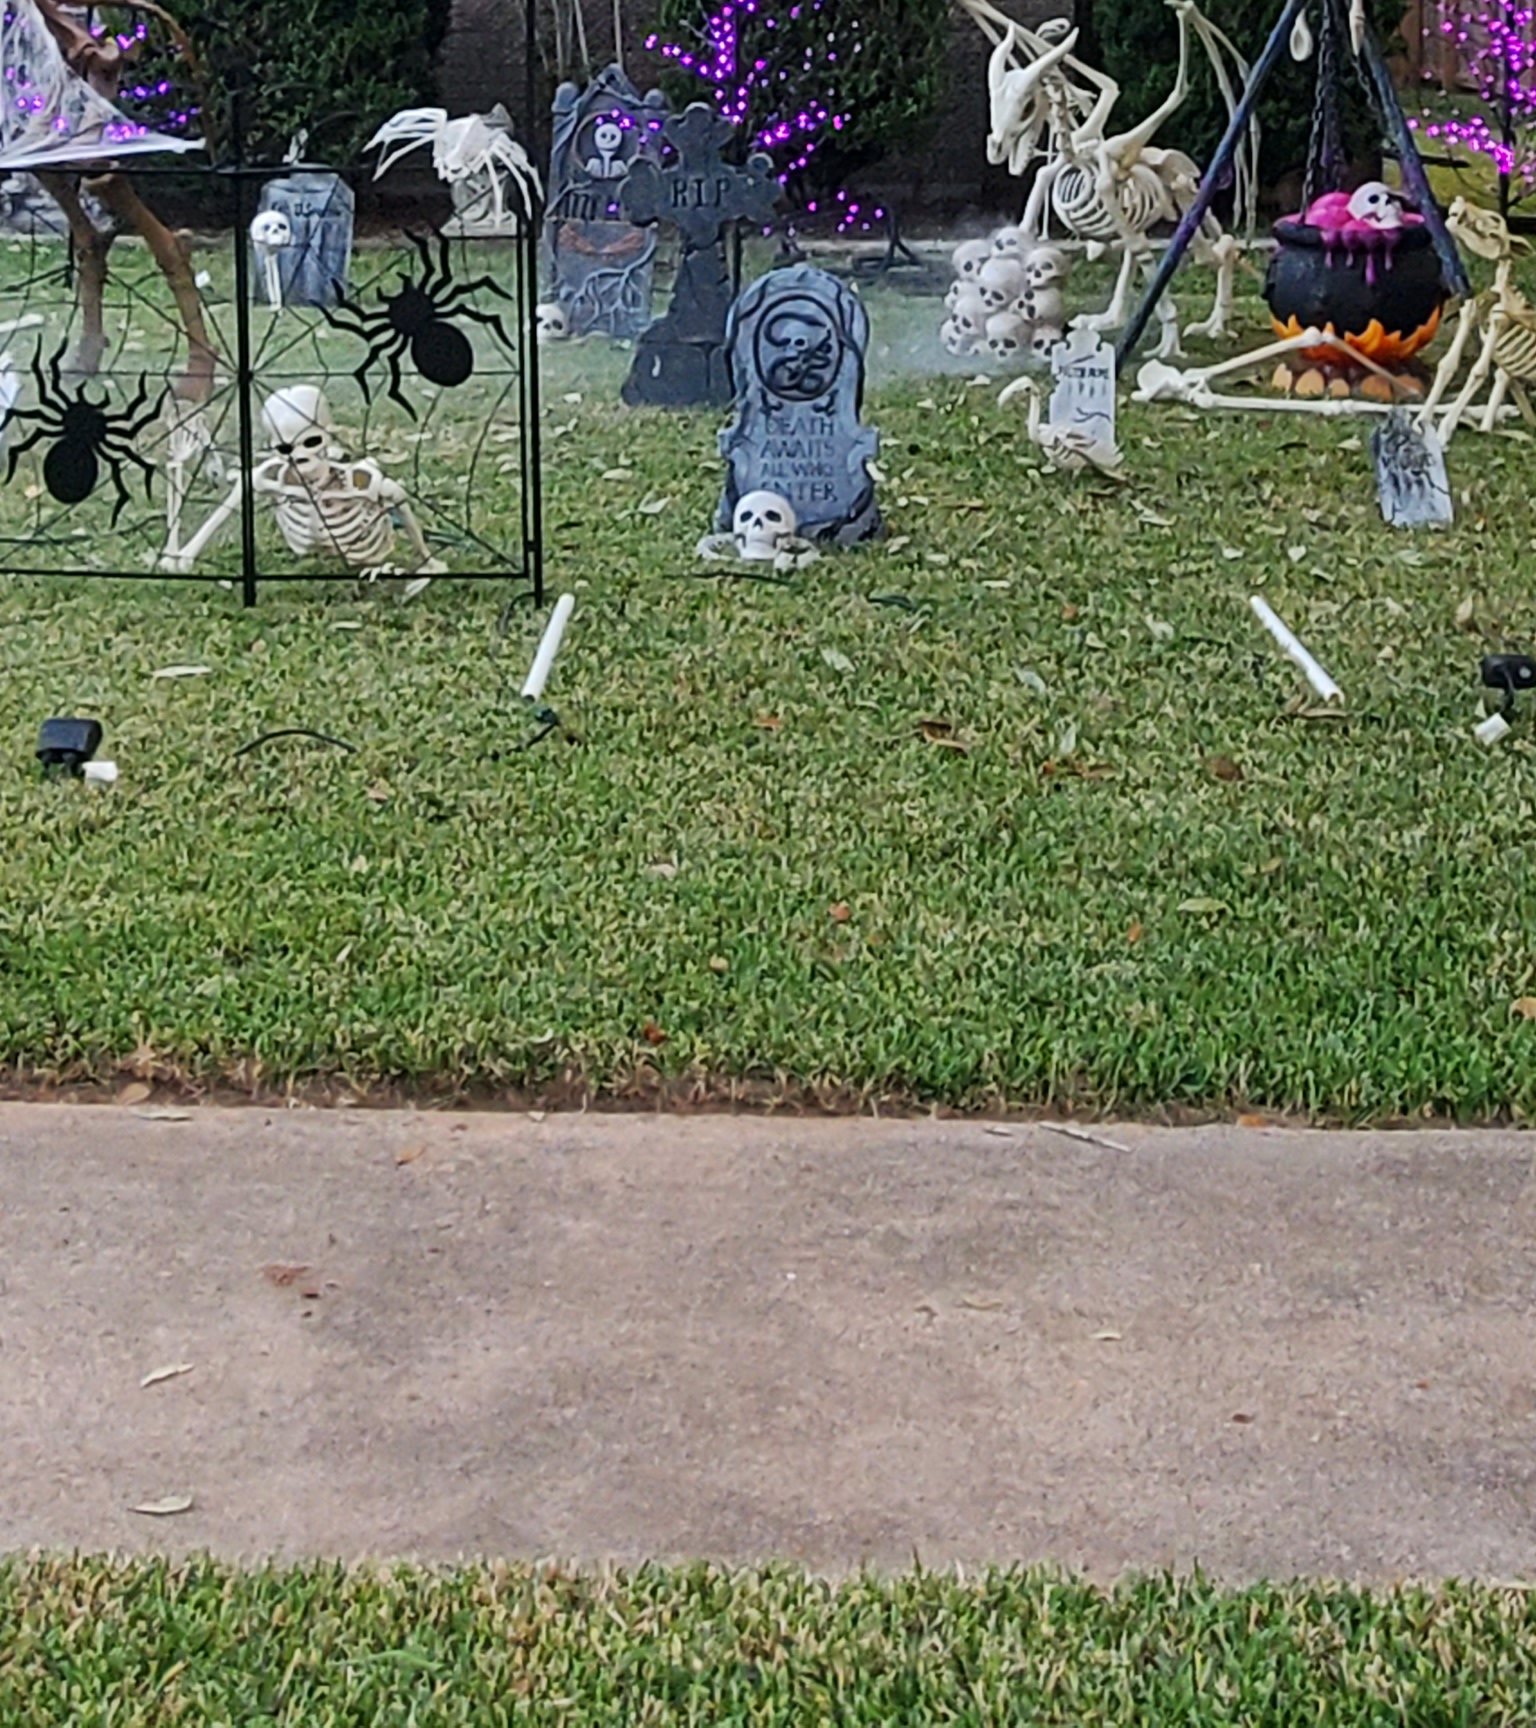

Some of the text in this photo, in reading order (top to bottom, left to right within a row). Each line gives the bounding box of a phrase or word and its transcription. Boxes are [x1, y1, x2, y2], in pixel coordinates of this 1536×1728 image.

[671, 178, 731, 209] RIP
[765, 416, 836, 436] DEATH
[760, 438, 836, 460] AWAITS
[761, 460, 835, 478] ALL WHO
